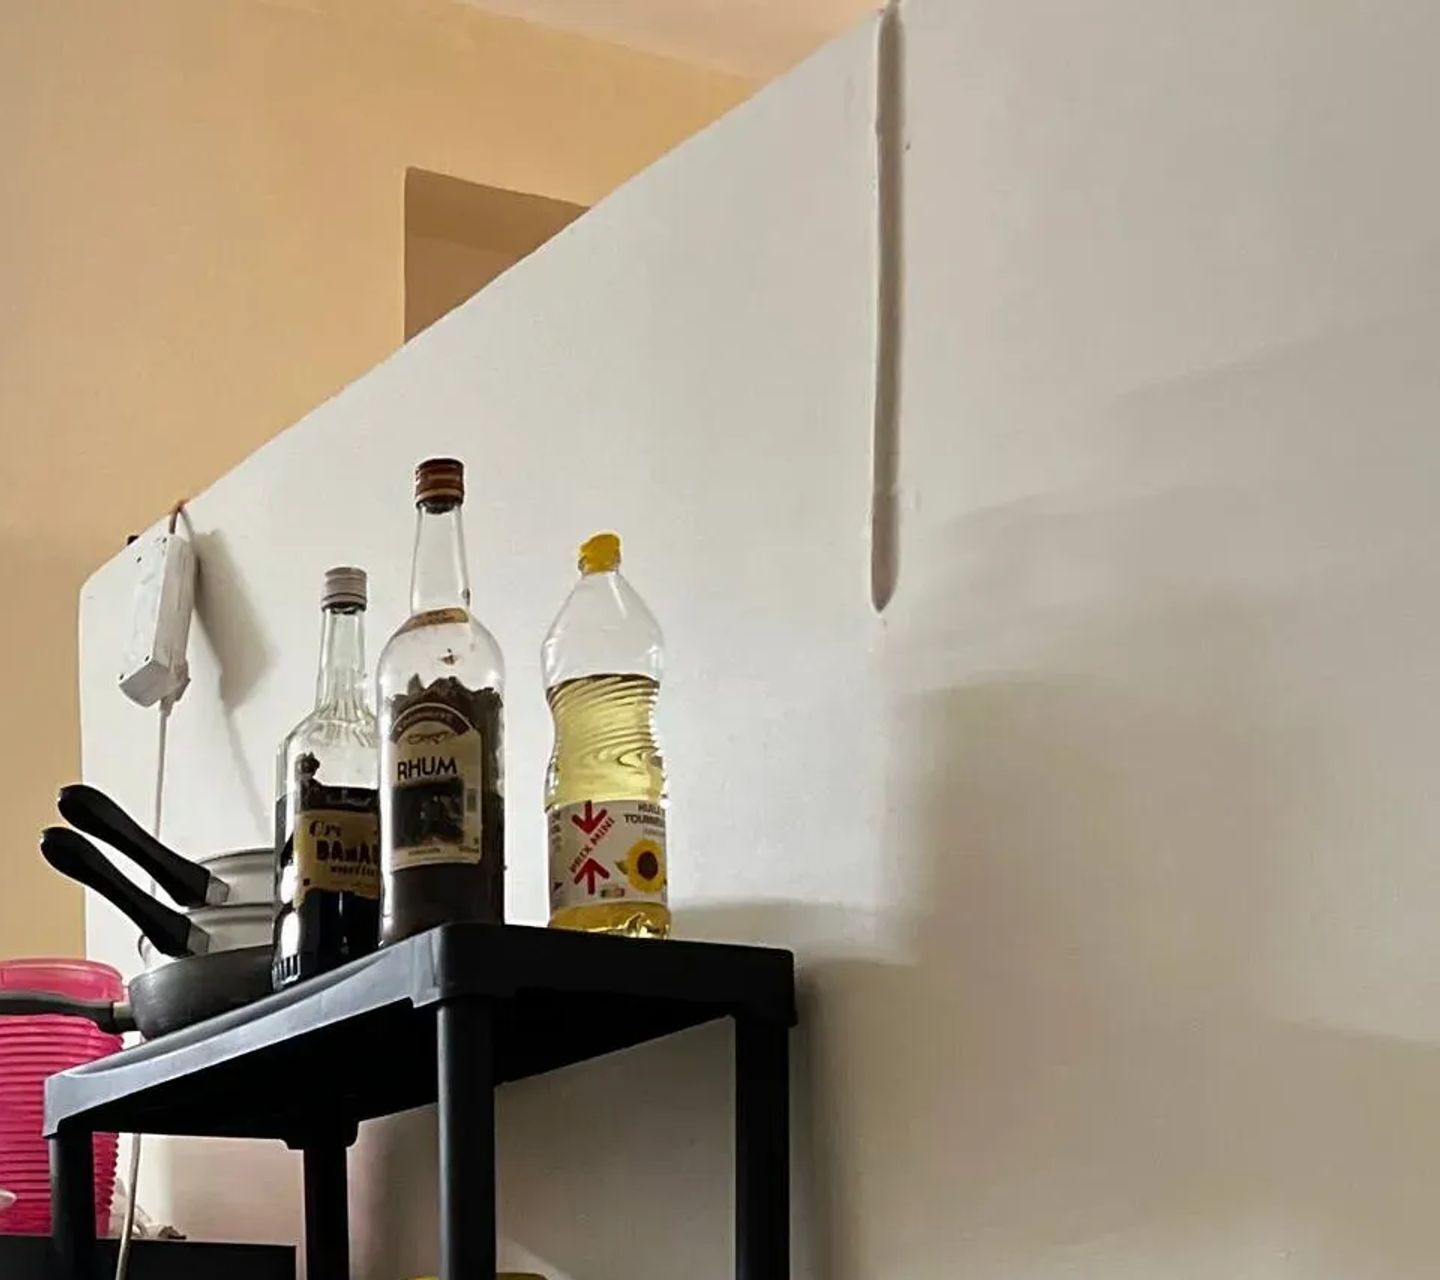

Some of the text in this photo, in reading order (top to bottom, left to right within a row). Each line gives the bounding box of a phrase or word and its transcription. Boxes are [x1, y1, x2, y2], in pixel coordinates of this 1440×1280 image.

[397, 756, 458, 781] RHUM
[569, 816, 615, 873] PRIX MINI
